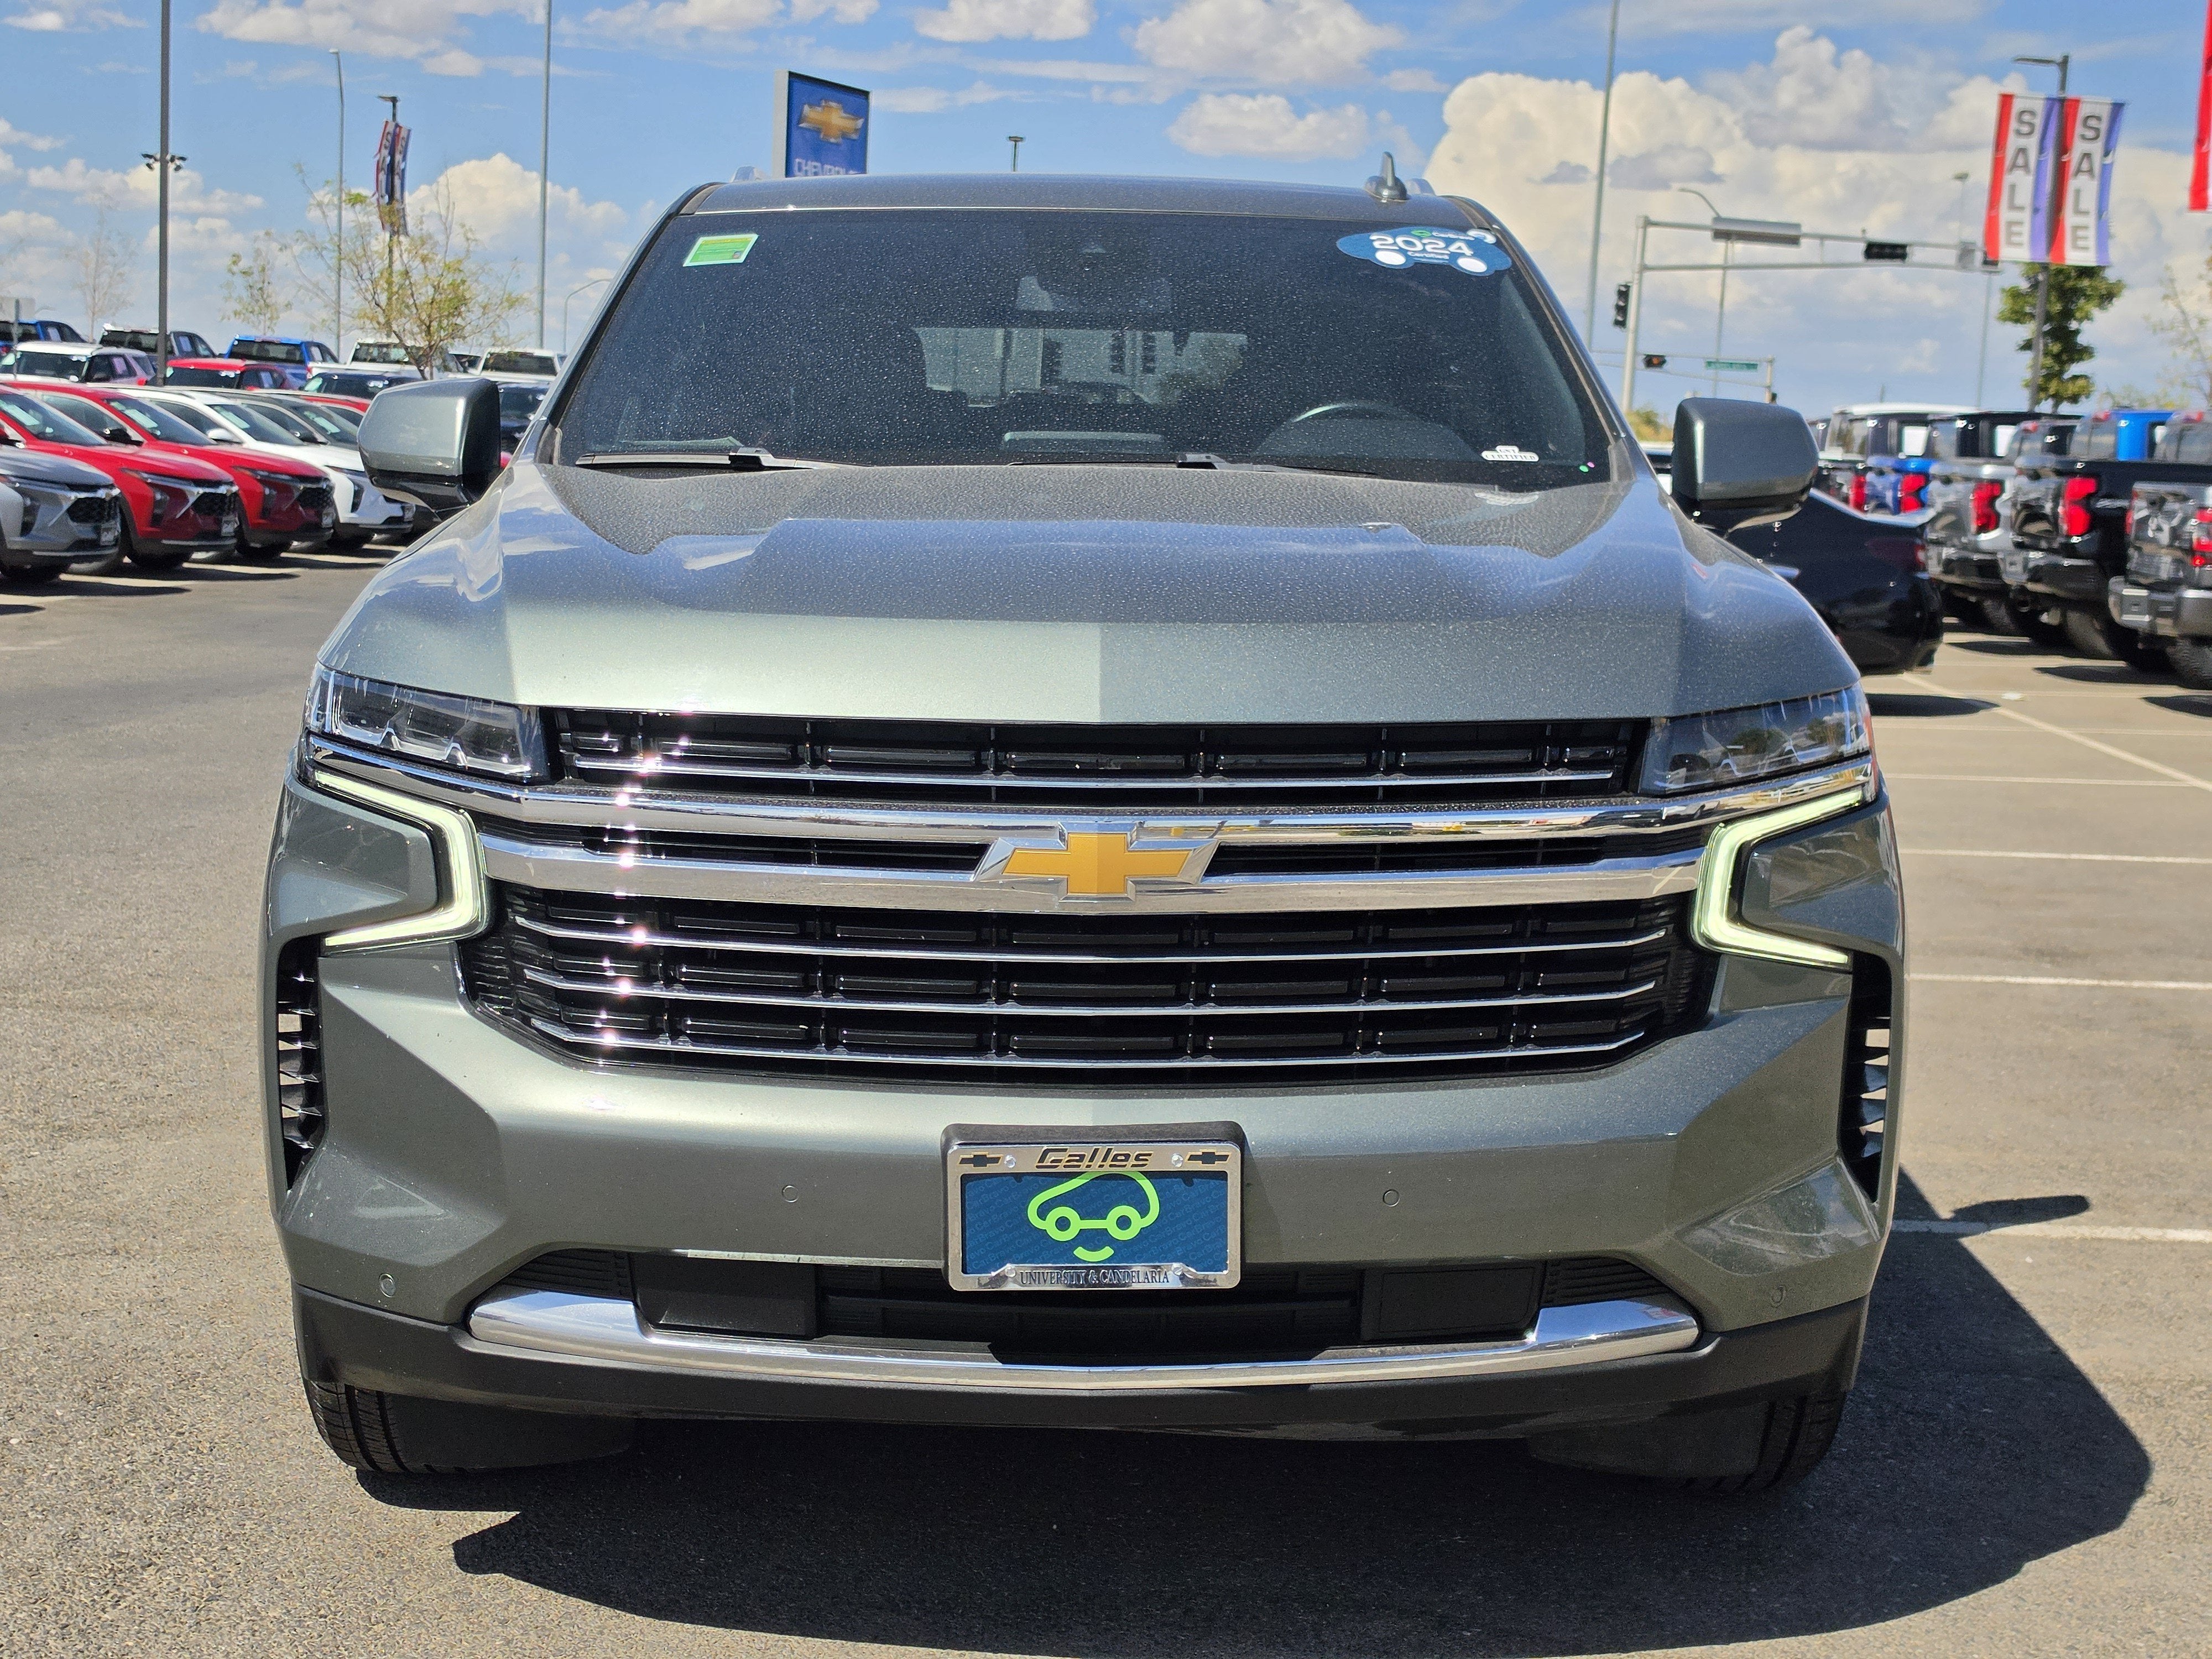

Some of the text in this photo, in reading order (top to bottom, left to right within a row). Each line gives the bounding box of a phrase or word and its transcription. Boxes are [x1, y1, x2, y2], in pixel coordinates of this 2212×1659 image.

[2005, 109, 2037, 246] SALE
[2070, 114, 2102, 251] SALE
[1369, 234, 1474, 256] 2024
[1035, 1146, 1154, 1169] Galles
[1020, 1270, 1170, 1285] UNIVERSITY & CANDELARIA
